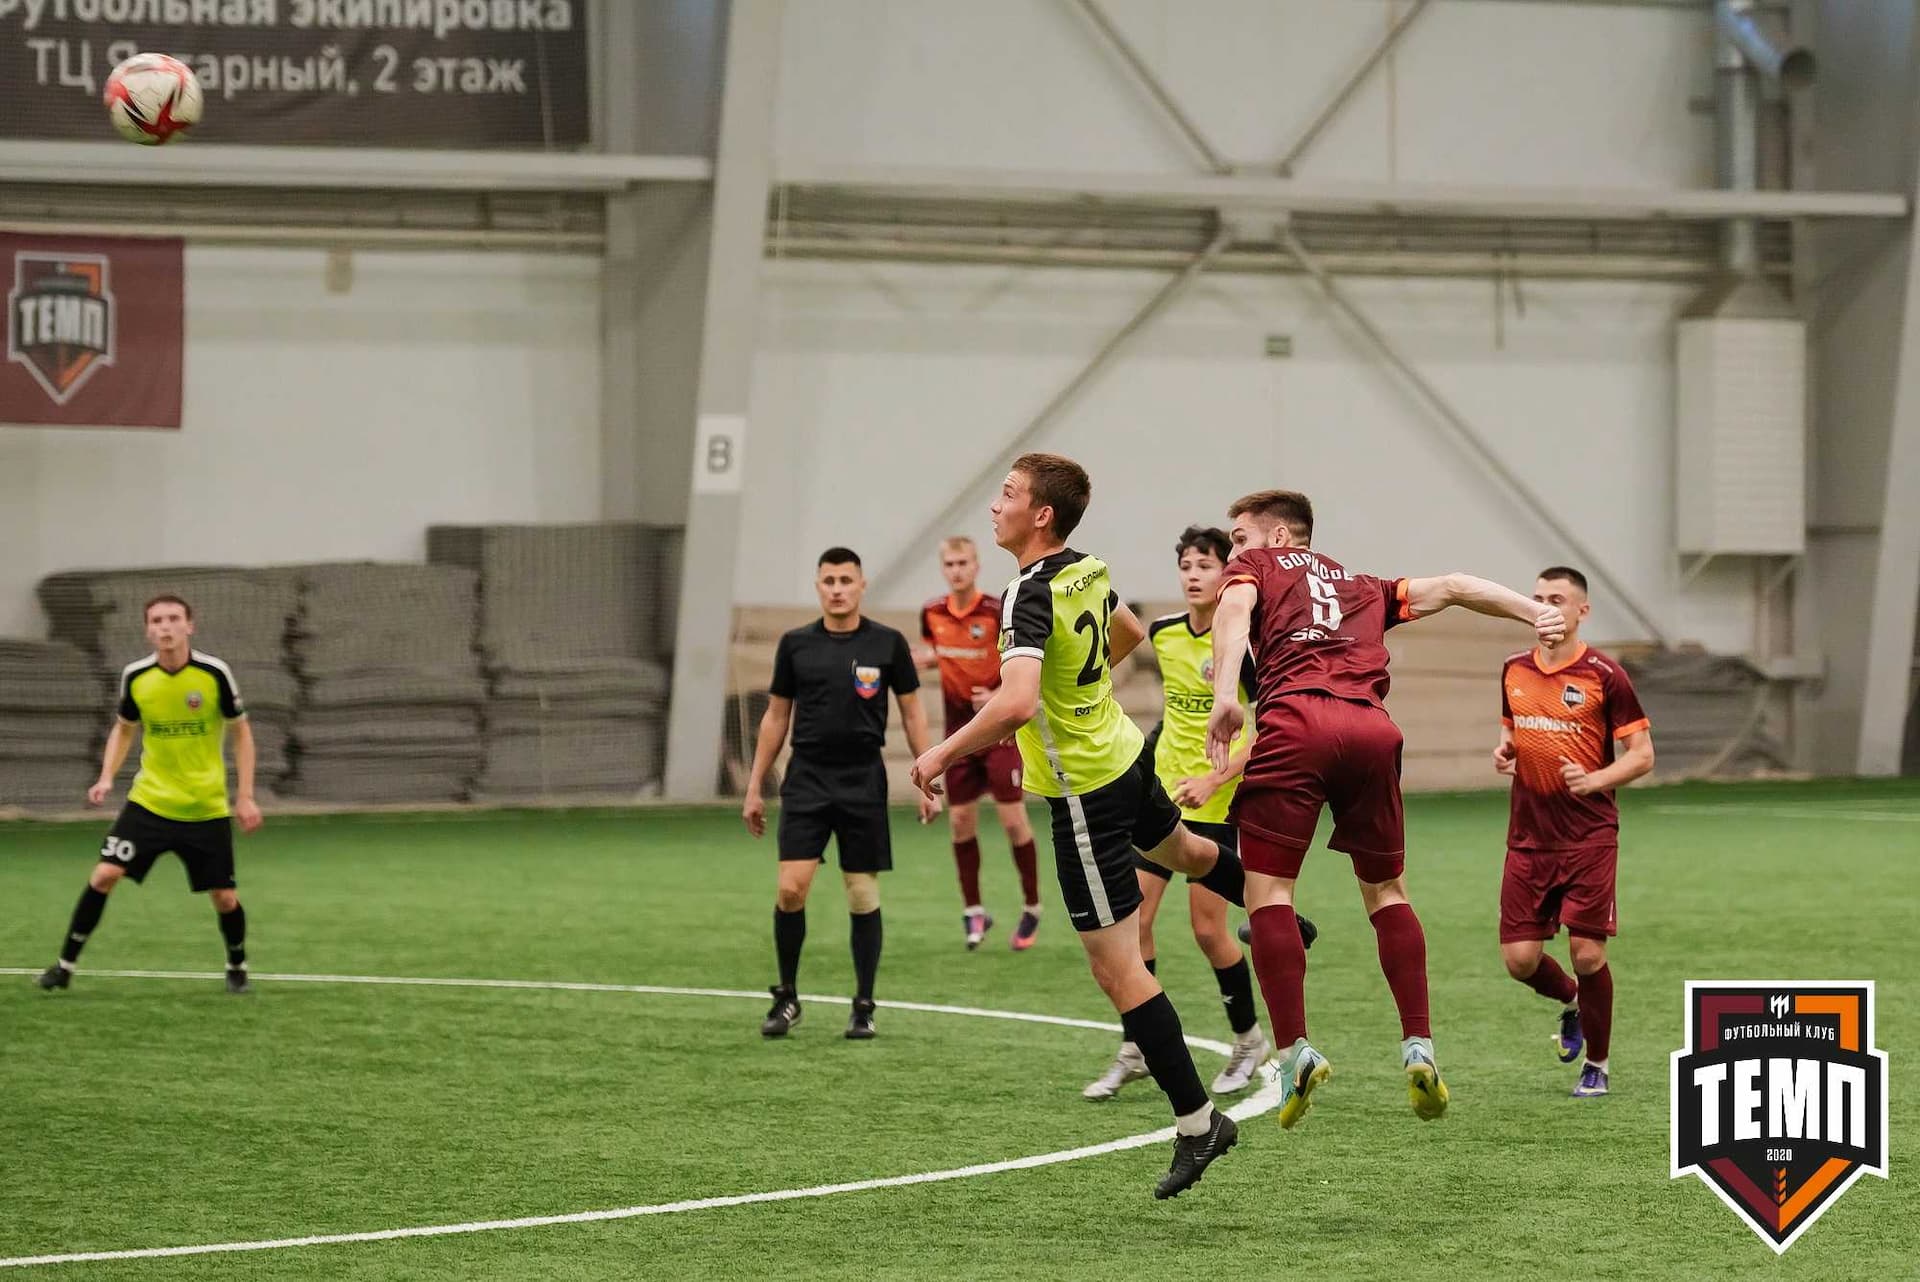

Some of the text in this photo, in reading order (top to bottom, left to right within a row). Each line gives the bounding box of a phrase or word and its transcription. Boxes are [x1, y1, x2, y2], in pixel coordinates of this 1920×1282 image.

[290, 0, 572, 39] экипировка
[27, 39, 96, 95] ТЦ
[372, 44, 398, 92] 2
[412, 57, 527, 94] этаж
[18, 293, 105, 348] ТЕМП
[1306, 571, 1344, 631] 5
[101, 835, 136, 862] 30
